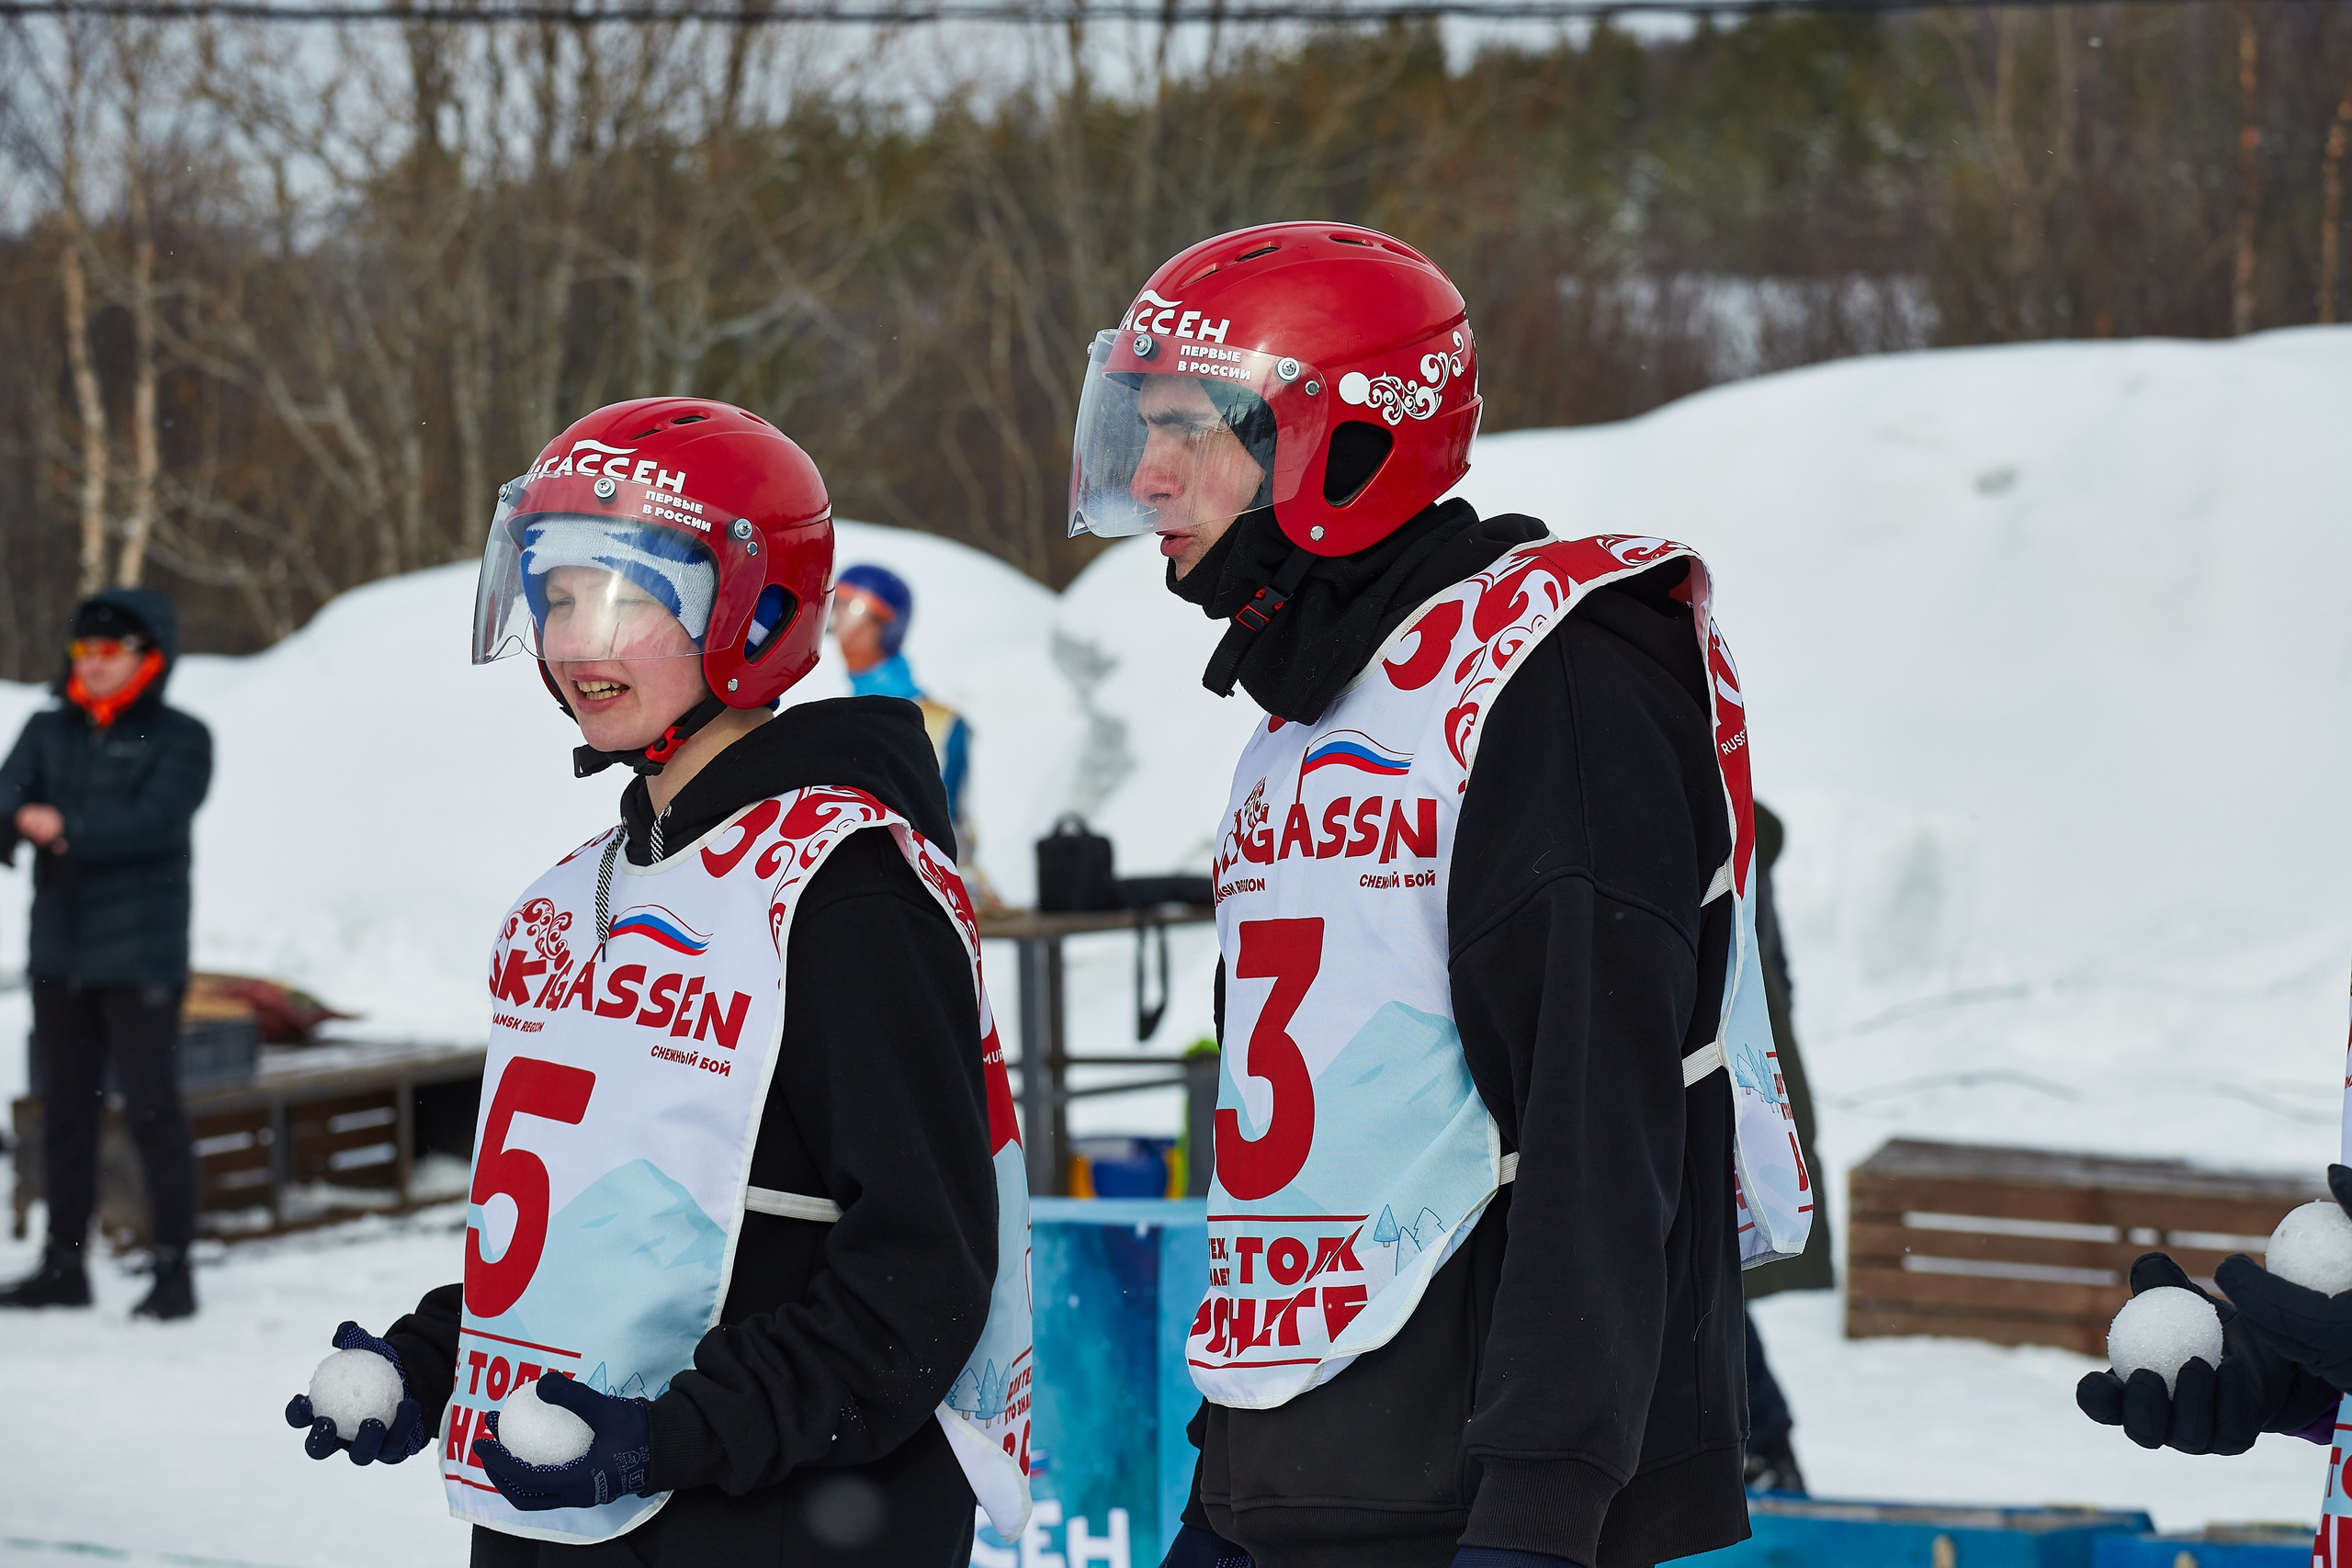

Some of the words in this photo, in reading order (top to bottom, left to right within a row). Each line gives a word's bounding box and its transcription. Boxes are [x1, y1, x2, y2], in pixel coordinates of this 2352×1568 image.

[1180, 344, 1242, 363] ПЕРВЫЕ
[1177, 360, 1187, 372] В
[1189, 361, 1252, 381] РОССИИ
[645, 490, 704, 515] ПЕРВЫЕ
[642, 504, 651, 515] В
[654, 506, 713, 533] РОССИИ
[1404, 869, 1436, 888] БОЙ
[650, 1044, 699, 1066] СНЕЖНЫЙ
[699, 1056, 731, 1077] БОЙ
[1214, 917, 1325, 1201] 3
[464, 1056, 596, 1319] 5
